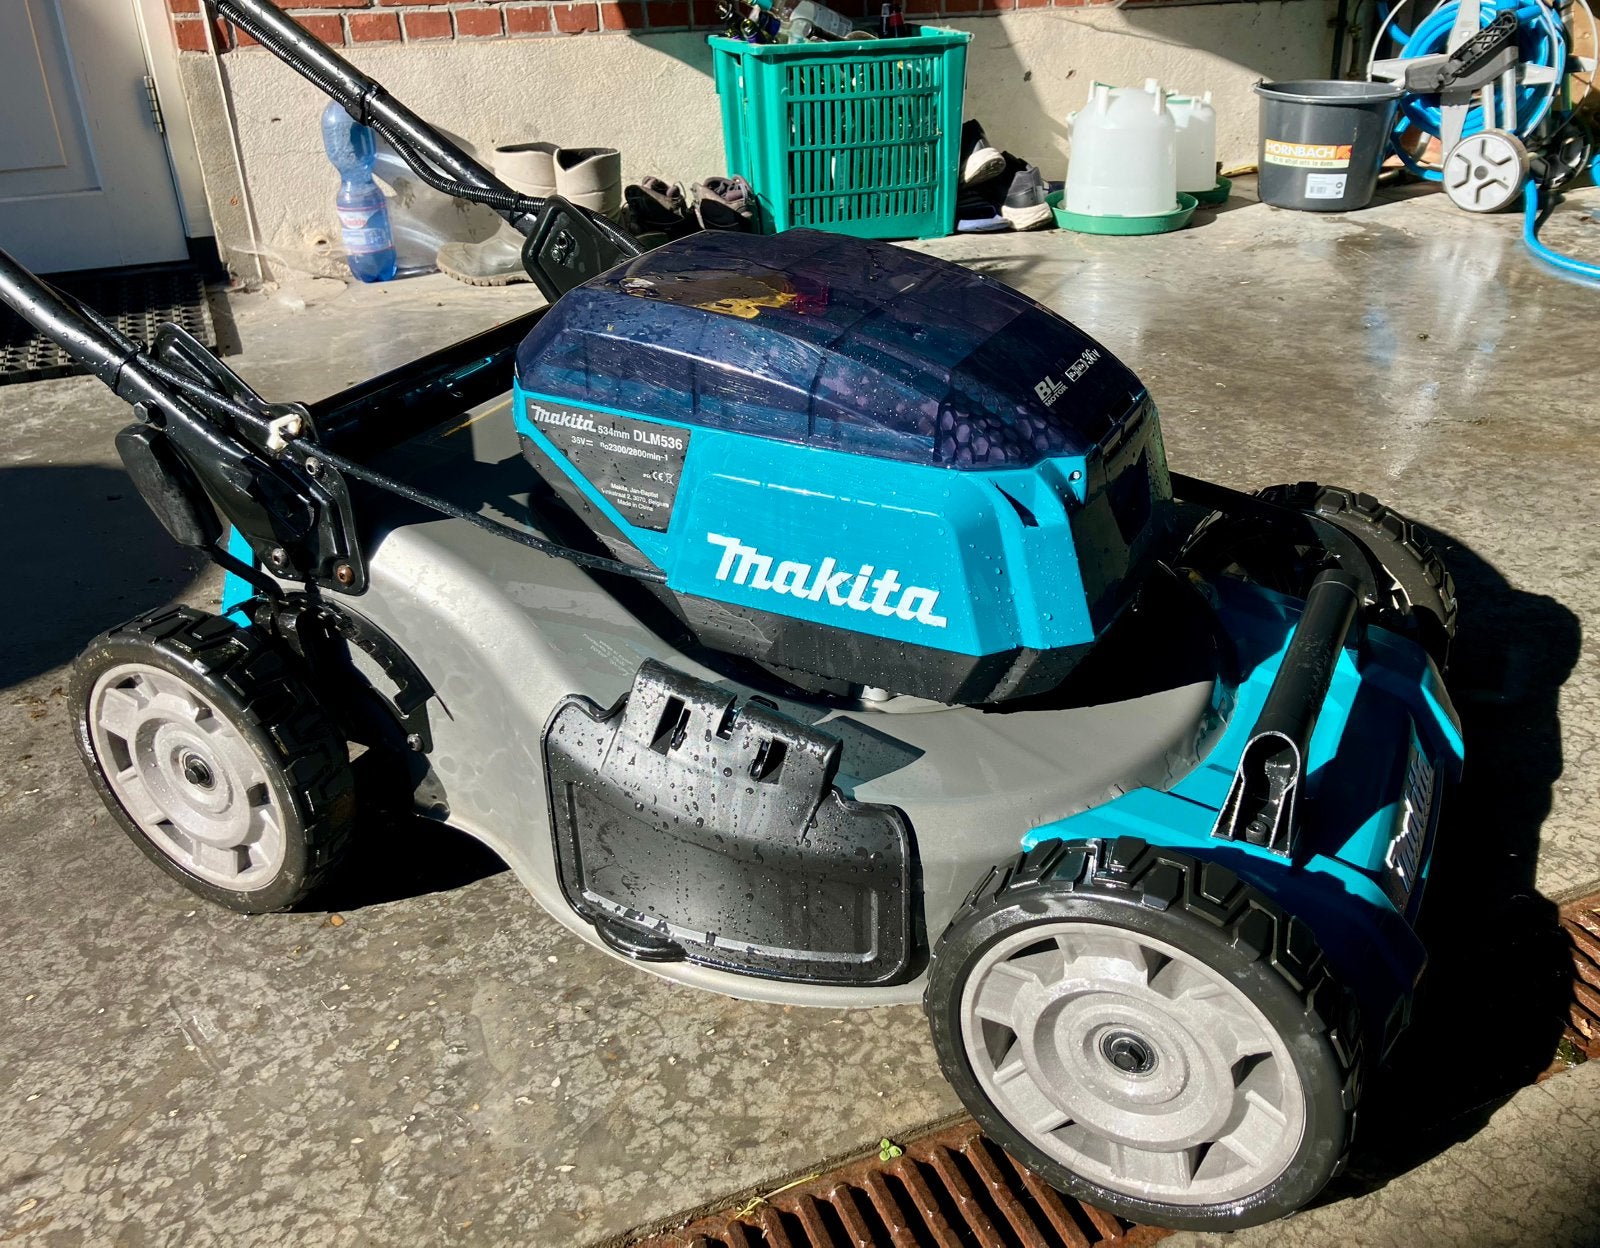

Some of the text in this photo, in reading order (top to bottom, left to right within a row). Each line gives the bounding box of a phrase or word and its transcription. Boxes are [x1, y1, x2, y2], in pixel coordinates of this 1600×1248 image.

[1267, 142, 1335, 158] HORNBACH
[1034, 375, 1062, 401] BL
[1044, 384, 1069, 407] MOTOR
[598, 425, 630, 440] 534mm
[633, 429, 683, 450] DLM536
[617, 498, 632, 507] Made
